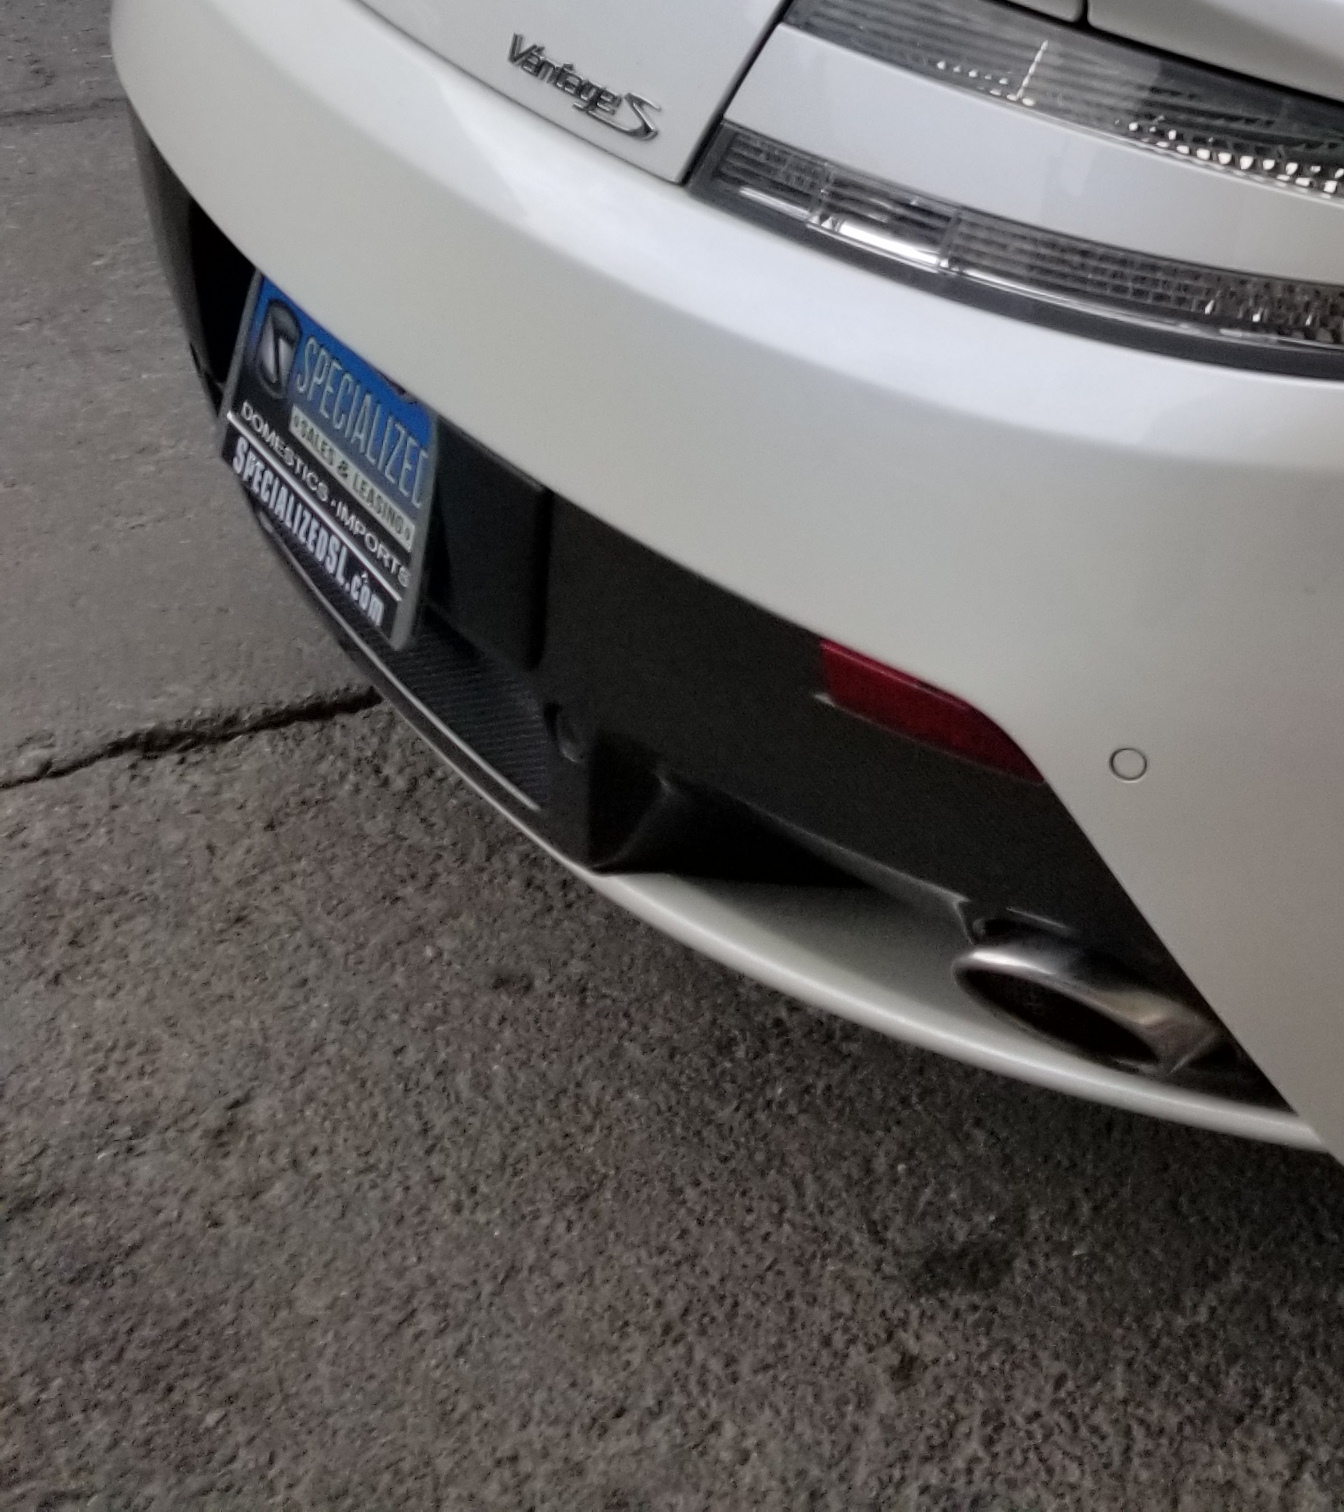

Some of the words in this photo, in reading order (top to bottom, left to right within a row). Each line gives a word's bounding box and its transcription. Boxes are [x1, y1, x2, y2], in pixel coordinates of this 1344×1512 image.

[508, 33, 623, 116] Vantage
[241, 400, 329, 502] DOMESTICS
[336, 501, 411, 588] IMPORTS
[298, 417, 335, 468] SALES
[353, 473, 404, 536] LEASING
